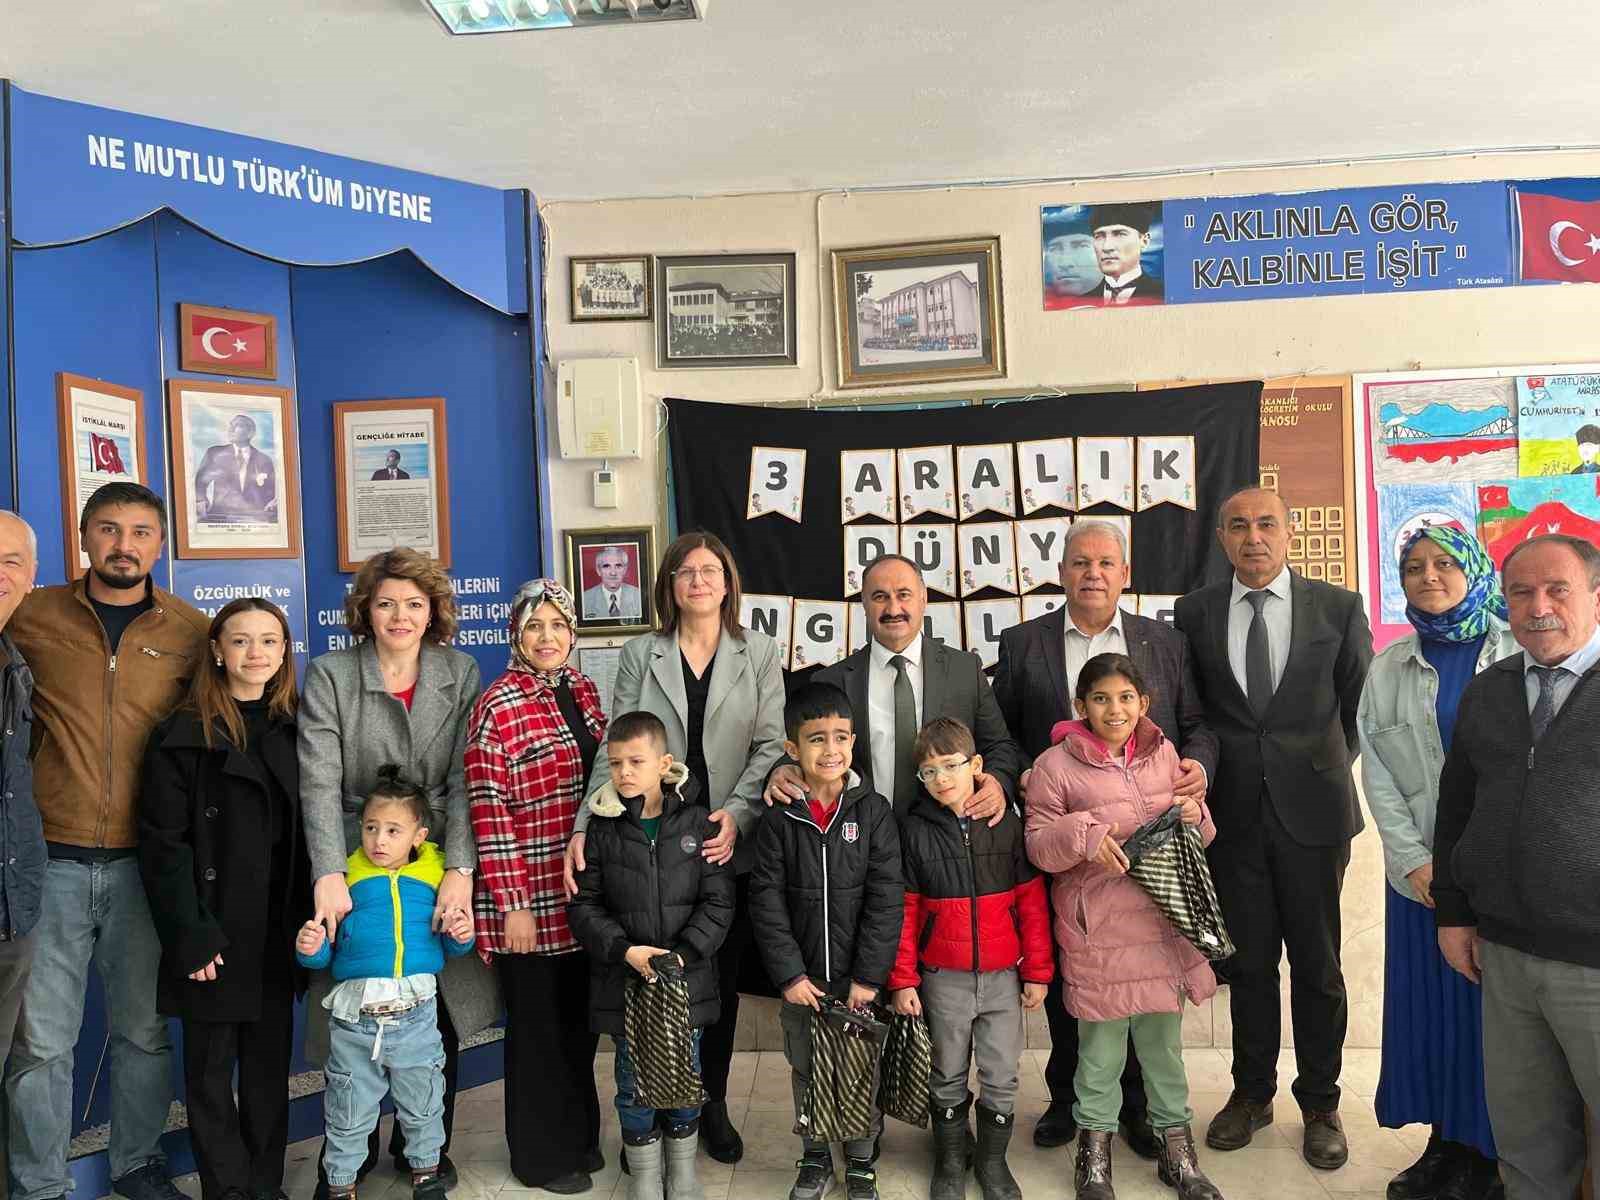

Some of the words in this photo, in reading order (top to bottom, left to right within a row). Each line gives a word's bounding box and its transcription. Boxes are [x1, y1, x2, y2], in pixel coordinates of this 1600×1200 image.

[88, 134, 126, 169] NE
[134, 142, 225, 186] MUTLU
[232, 159, 343, 207] TÜRK'ÜM
[1203, 204, 1360, 243] AKLINLA
[1369, 194, 1458, 234] GÖR,
[1193, 248, 1365, 289] KALBİNLE
[1377, 240, 1446, 287] İŞİT
[1457, 278, 1473, 286] Türk
[1304, 402, 1333, 412] OKULU
[1260, 416, 1299, 426] ANOSU
[397, 431, 425, 439] HİTABE
[765, 460, 788, 491] 3
[855, 449, 1180, 493] ARALIK
[858, 530, 1057, 572] DÜNY
[193, 584, 272, 600] ÖZGÜRLÜK
[275, 587, 291, 597] ve
[328, 634, 346, 650] EN
